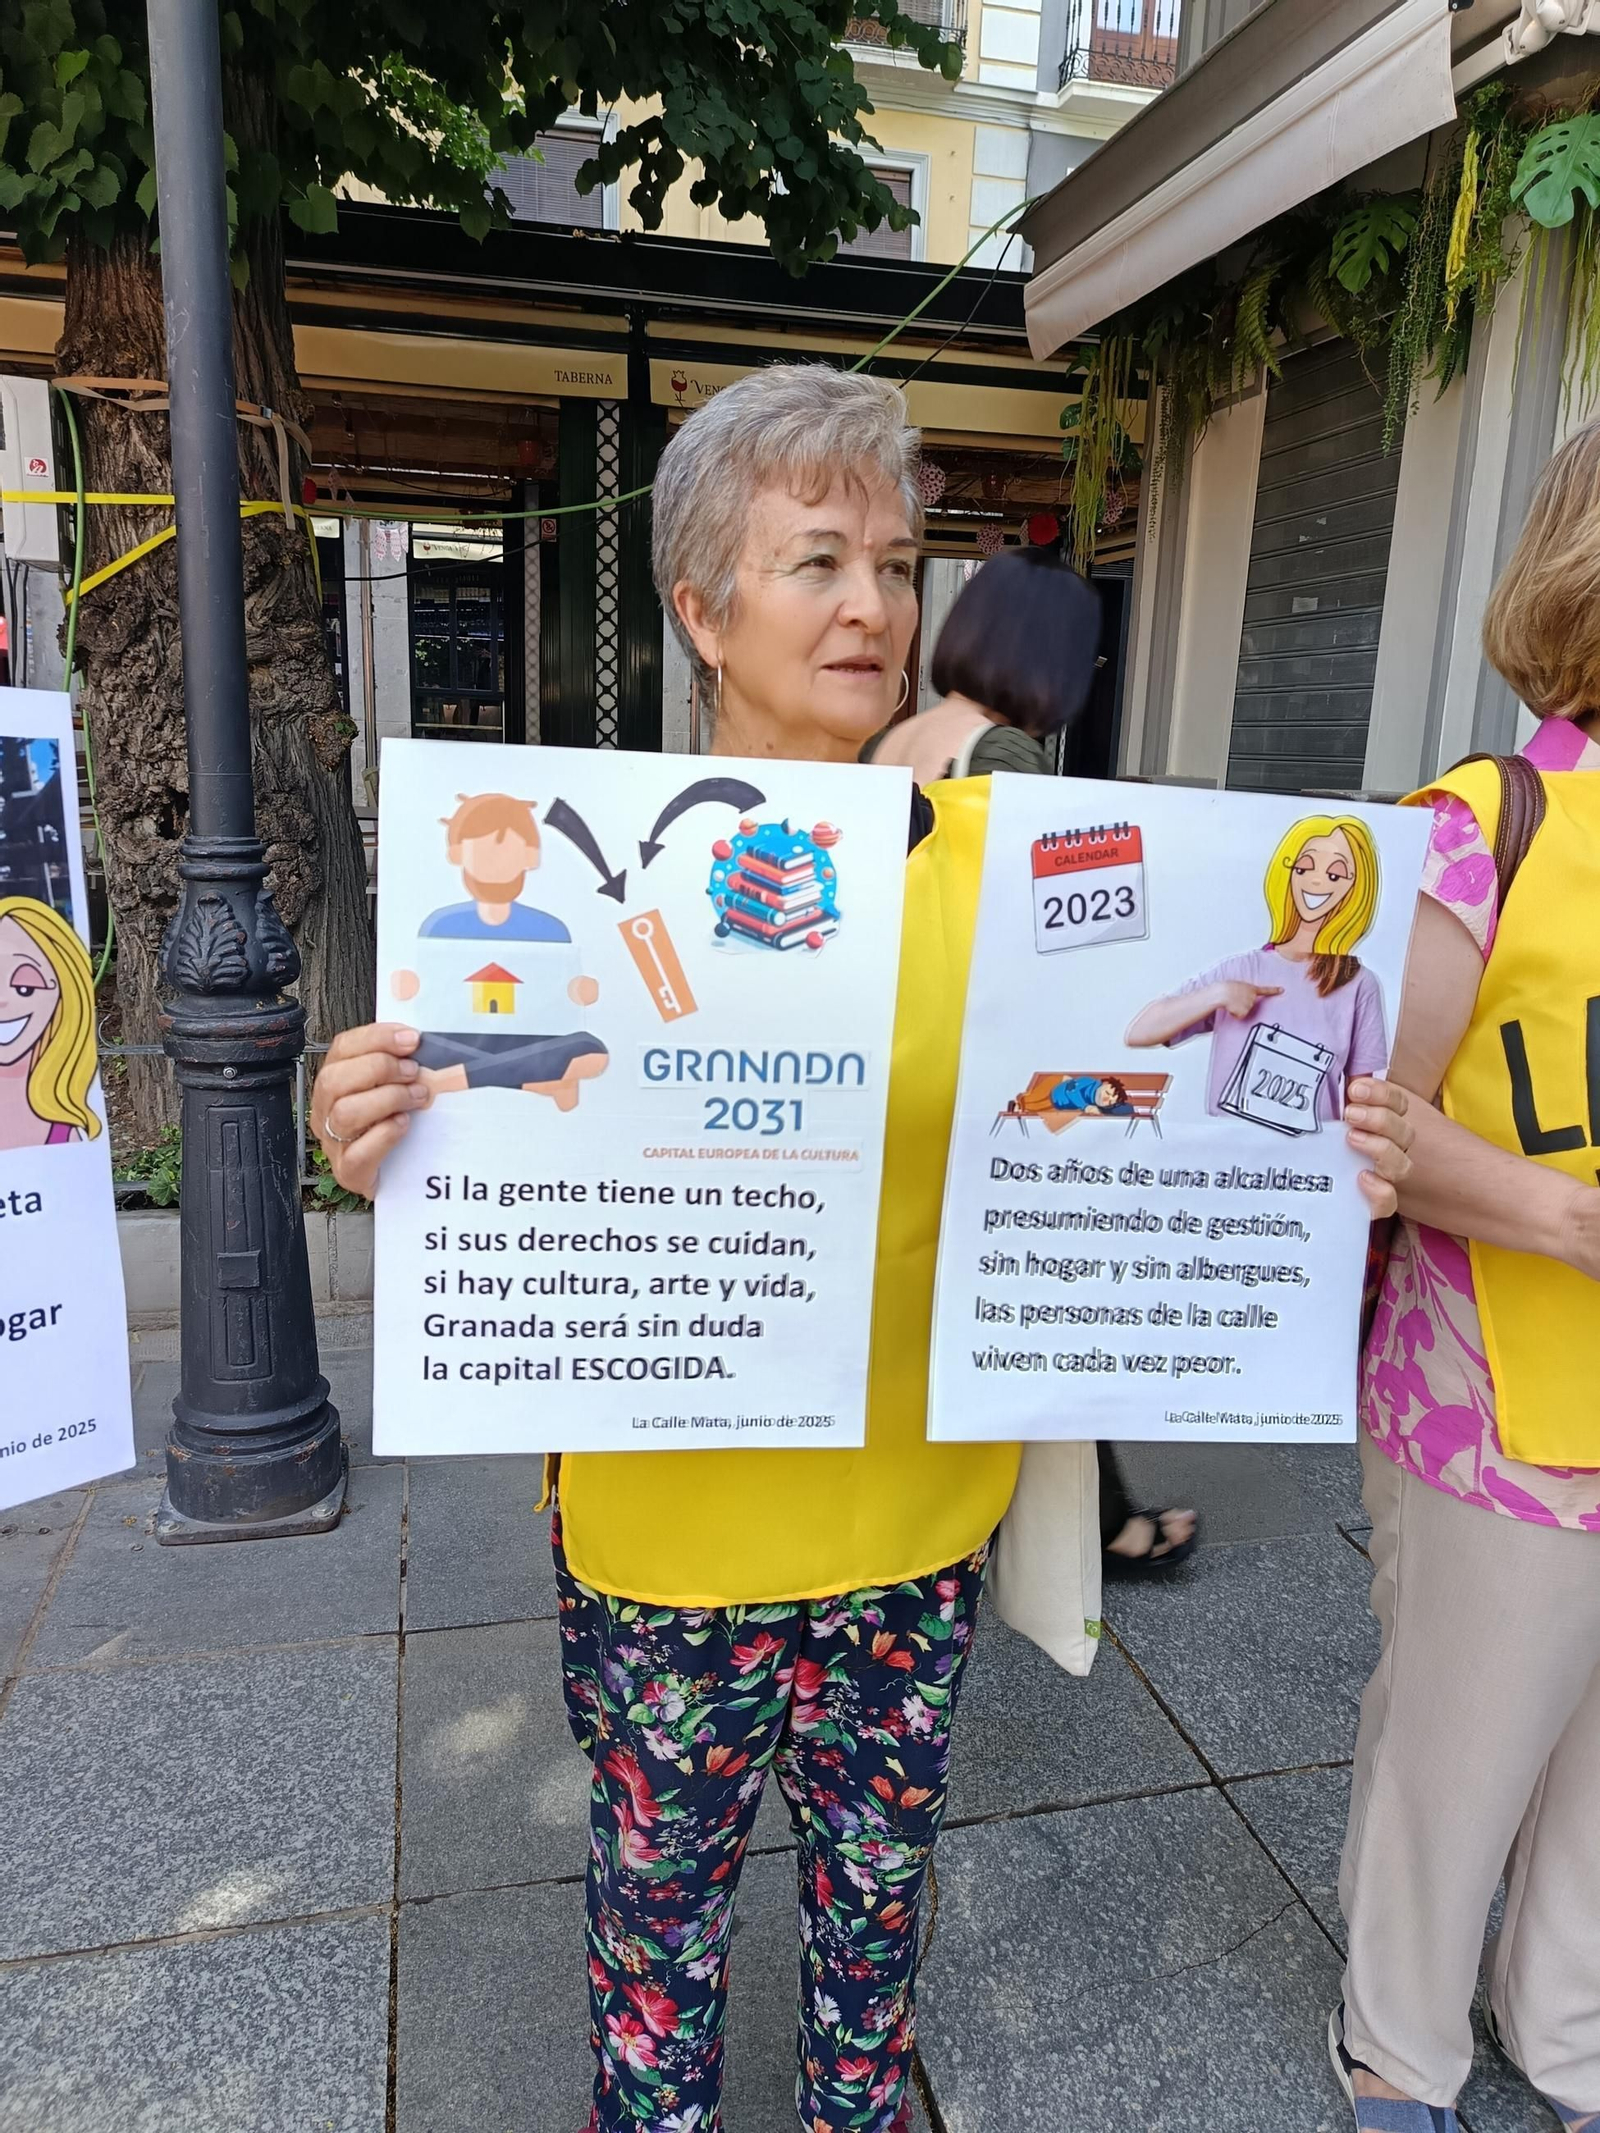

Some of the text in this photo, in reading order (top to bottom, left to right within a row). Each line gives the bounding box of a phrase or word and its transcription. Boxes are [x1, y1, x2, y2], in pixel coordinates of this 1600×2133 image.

[554, 370, 613, 385] TABERNA
[1055, 848, 1119, 867] CALENDAR
[1044, 886, 1136, 929] 2023
[643, 1048, 865, 1086] GRANADA
[1251, 1068, 1313, 1111] 2025
[704, 1097, 803, 1135] 2031
[643, 1147, 859, 1161] CAPITAL EUROPEA DE LA CULTURA
[990, 1157, 1334, 1193] Dos años de una alcaldesa
[425, 1175, 826, 1214] Si la gente tiene un techo,
[984, 1206, 1312, 1243] presumiendo de gestión,
[425, 1226, 817, 1261] si sus derechos se cuidan,
[424, 1269, 817, 1302] si hay cultura, arte y vida,
[979, 1251, 1311, 1288] sin hogar y sin albergues,
[423, 1312, 764, 1339] Granada será sin duda
[975, 1296, 1279, 1330] las personas de la calle
[423, 1356, 736, 1386] la capital ESCOGIDA.
[972, 1345, 1242, 1379] viven cada vez peor.
[32, 1432, 53, 1449] de
[57, 1418, 97, 1441] 2025
[632, 1415, 836, 1430] La Calle Mata, junio de 2025
